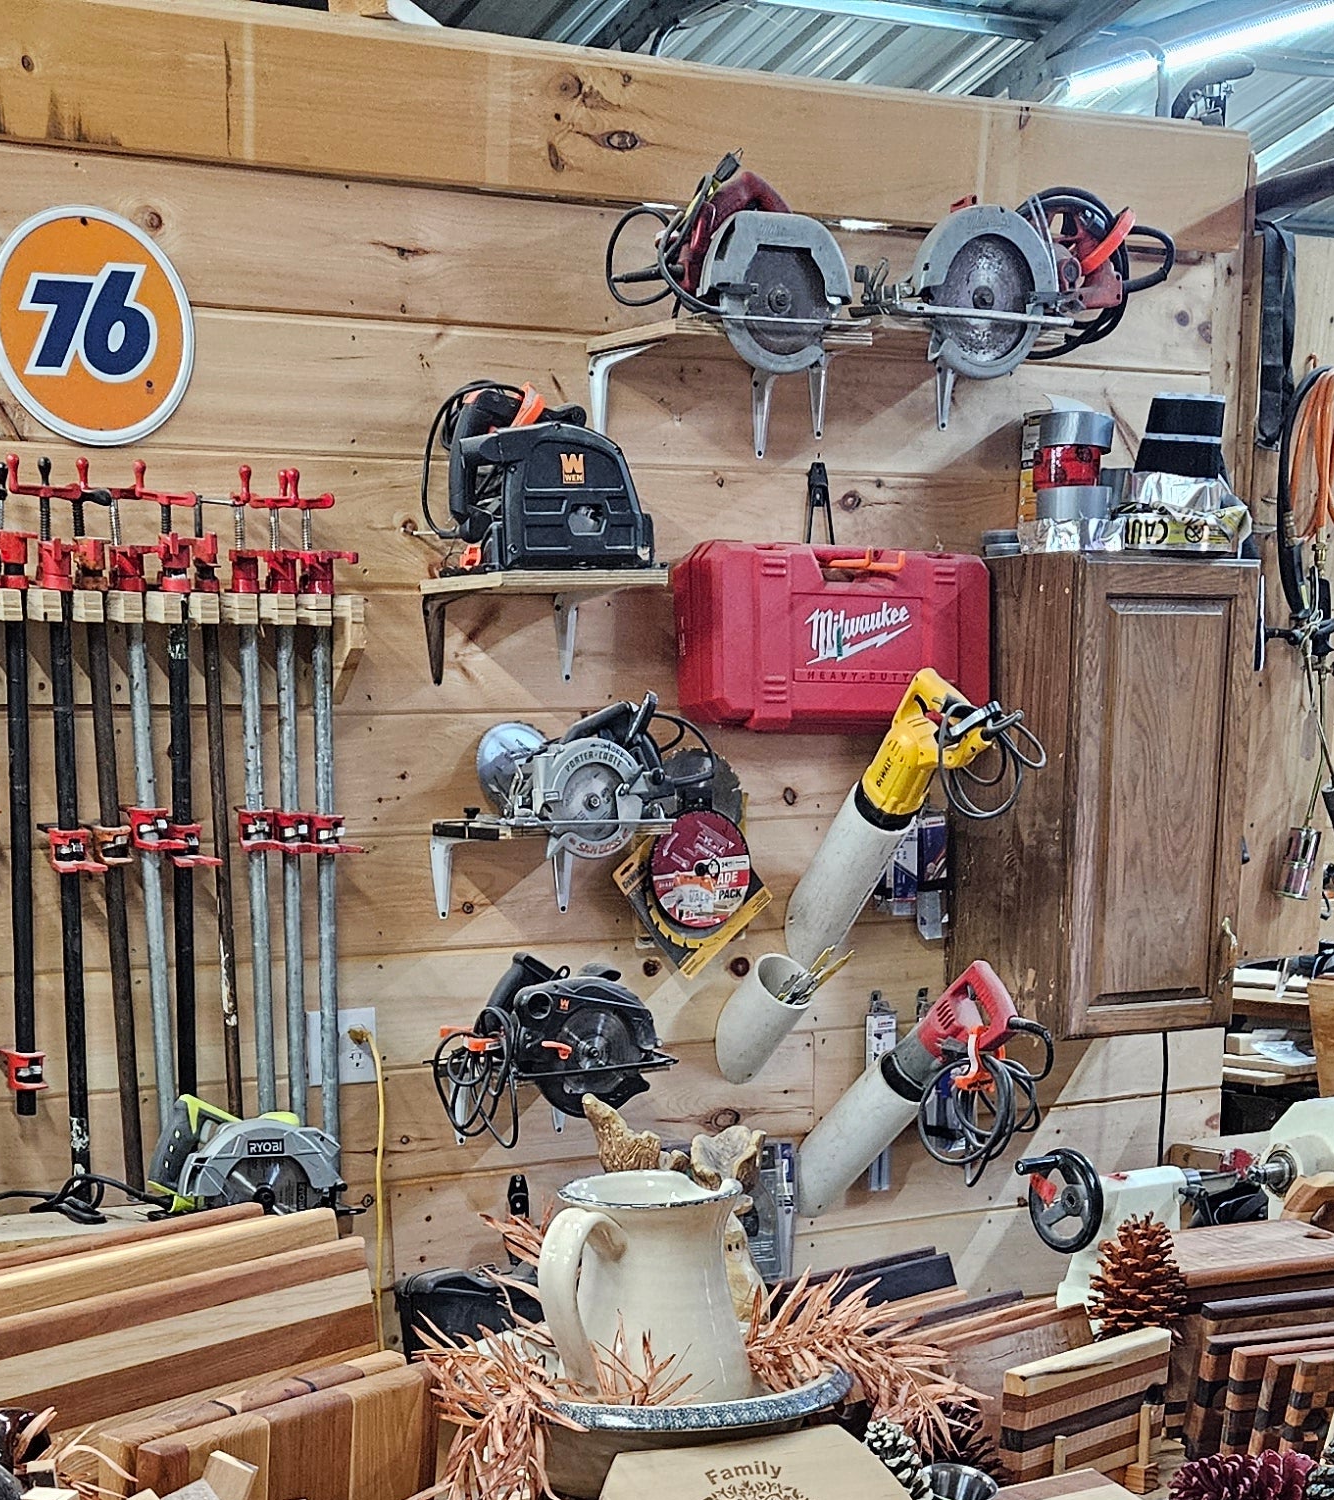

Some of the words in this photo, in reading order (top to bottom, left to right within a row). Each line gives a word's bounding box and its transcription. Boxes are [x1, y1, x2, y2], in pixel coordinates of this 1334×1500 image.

[25, 266, 154, 380] 76
[564, 474, 583, 482] WEN
[1125, 518, 1168, 545] CAU
[804, 602, 910, 660] Milwaukee
[717, 871, 739, 885] ADE
[719, 888, 742, 901] PACK
[248, 1140, 284, 1154] RYOBI
[705, 1460, 783, 1486] Family
